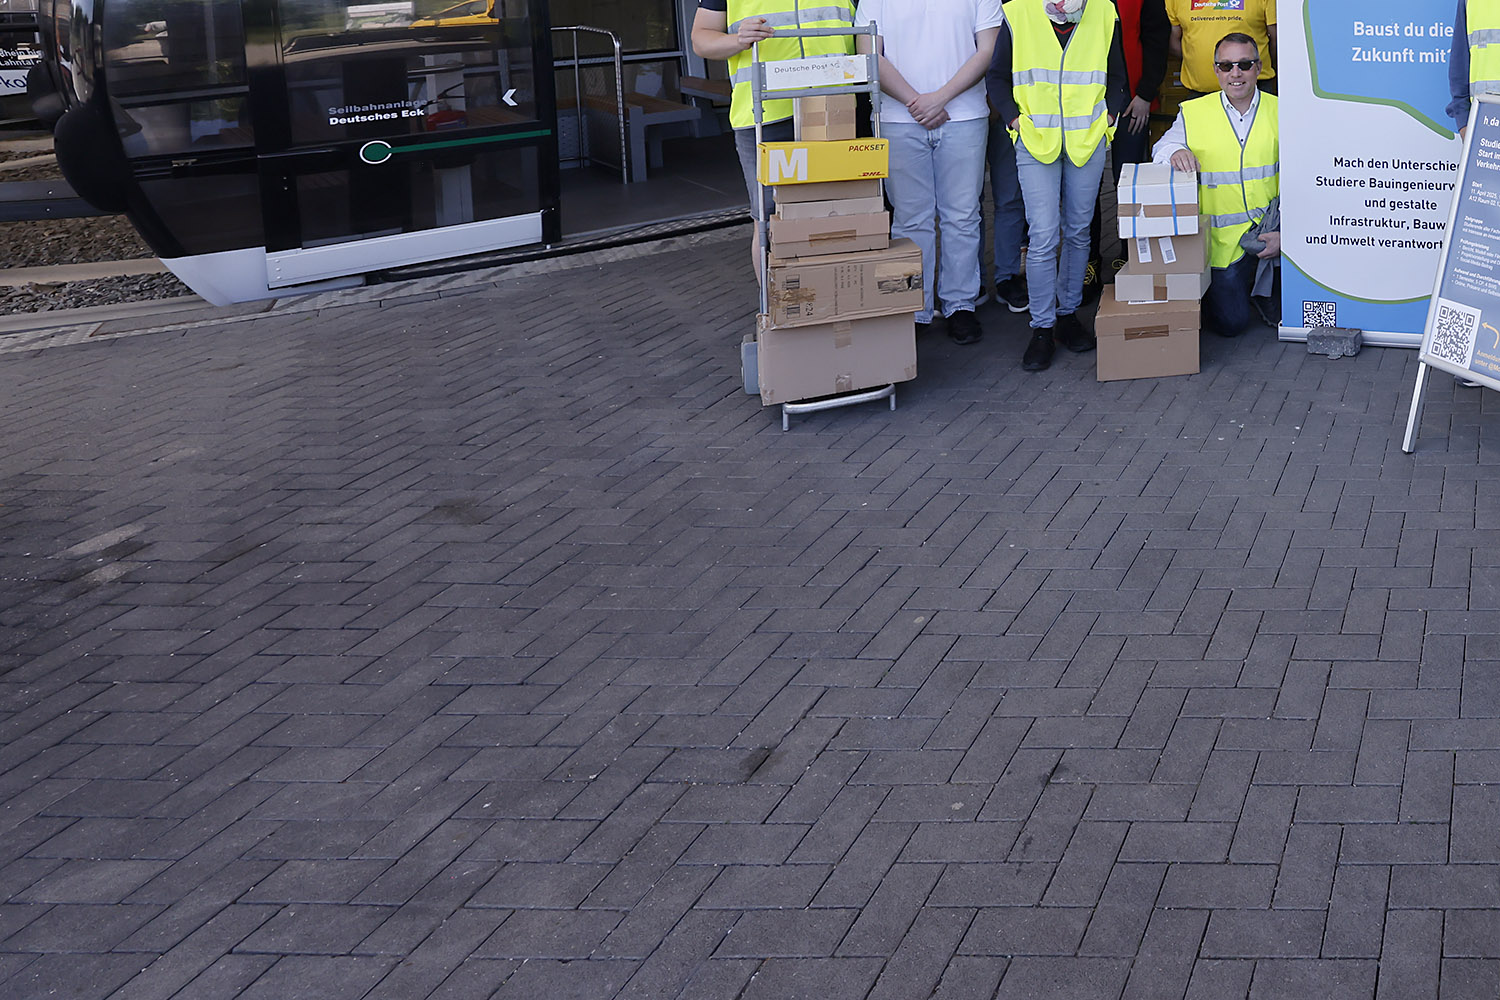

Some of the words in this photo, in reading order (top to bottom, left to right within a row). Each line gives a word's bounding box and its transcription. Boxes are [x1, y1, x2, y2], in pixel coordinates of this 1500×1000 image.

[1354, 22, 1400, 36] Baust
[1404, 22, 1424, 36] du
[1429, 23, 1454, 37] die
[1352, 47, 1414, 62] Zukunft
[328, 98, 428, 116] Seilbahnanlage
[329, 110, 398, 125] Deutsches
[401, 108, 425, 118] Eck
[1483, 116, 1500, 127] h_da
[848, 144, 885, 152] PACKSET
[1478, 149, 1493, 158] Start
[769, 148, 808, 182] M
[1334, 157, 1364, 168] Mach
[1367, 158, 1388, 169] den
[1316, 176, 1365, 187] Studiere
[1369, 178, 1455, 192] Bauingenieurw
[1365, 198, 1386, 208] und
[1389, 200, 1437, 210] gestalte
[1330, 215, 1410, 230] Infrastruktur,
[1413, 219, 1446, 230] Bauw
[1306, 234, 1326, 244] und
[1330, 235, 1375, 246] Umwelt
